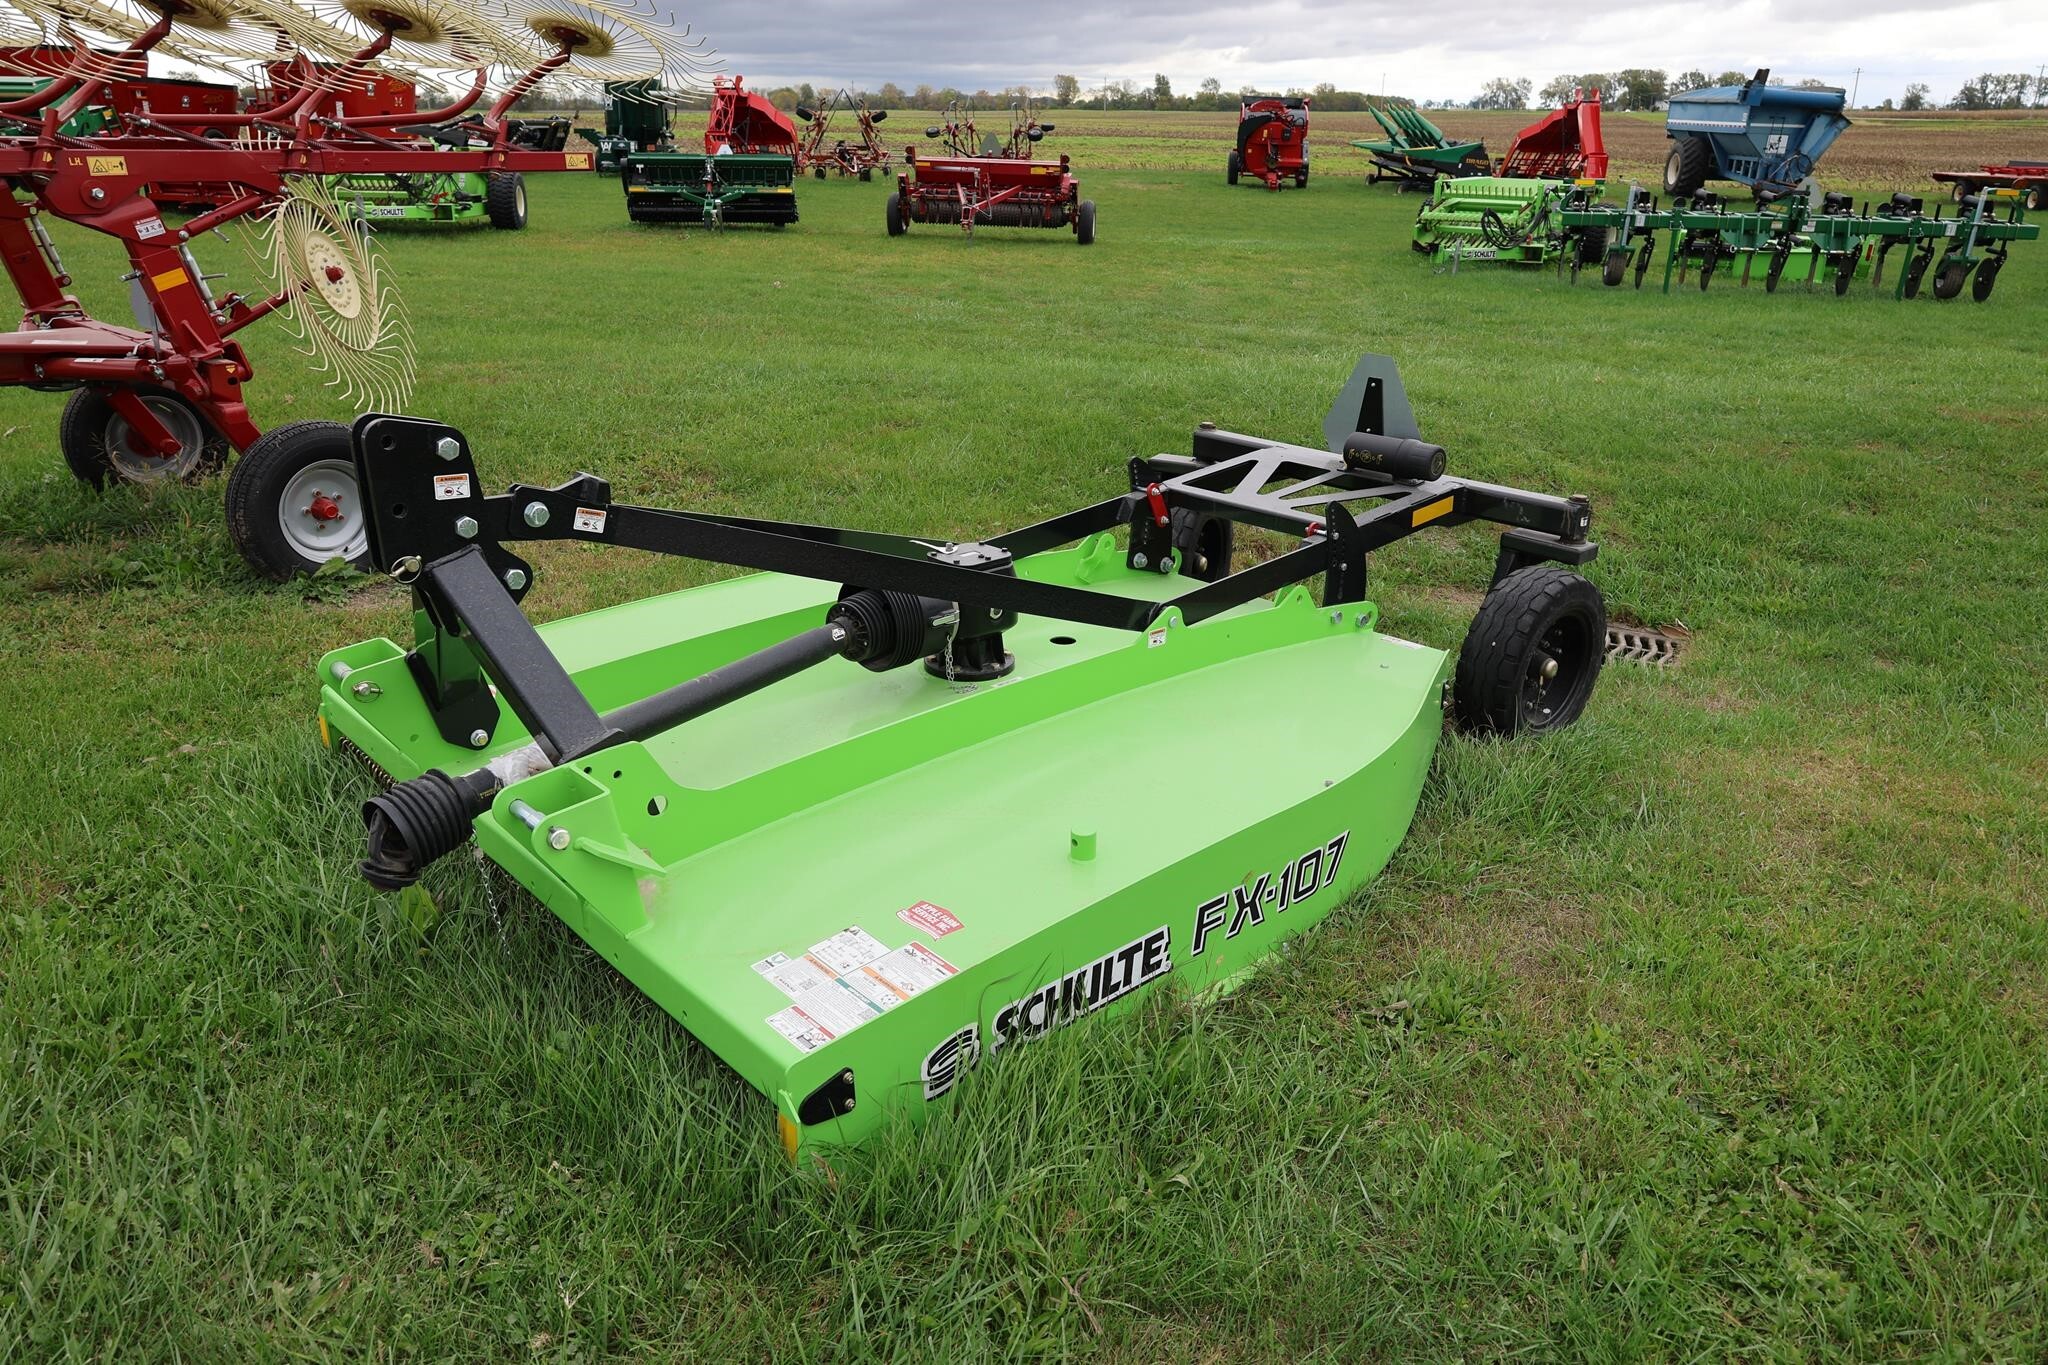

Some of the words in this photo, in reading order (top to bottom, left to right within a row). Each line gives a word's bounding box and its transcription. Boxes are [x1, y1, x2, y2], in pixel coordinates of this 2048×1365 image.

[380, 208, 404, 216] SCHULTE
[1474, 250, 1496, 258] SCHULTE
[1191, 830, 1349, 956] FX-107
[911, 905, 939, 924] SERVICE
[920, 902, 942, 917] APPLE
[939, 913, 960, 928] FARM
[994, 928, 1171, 1046] SCHULTE
